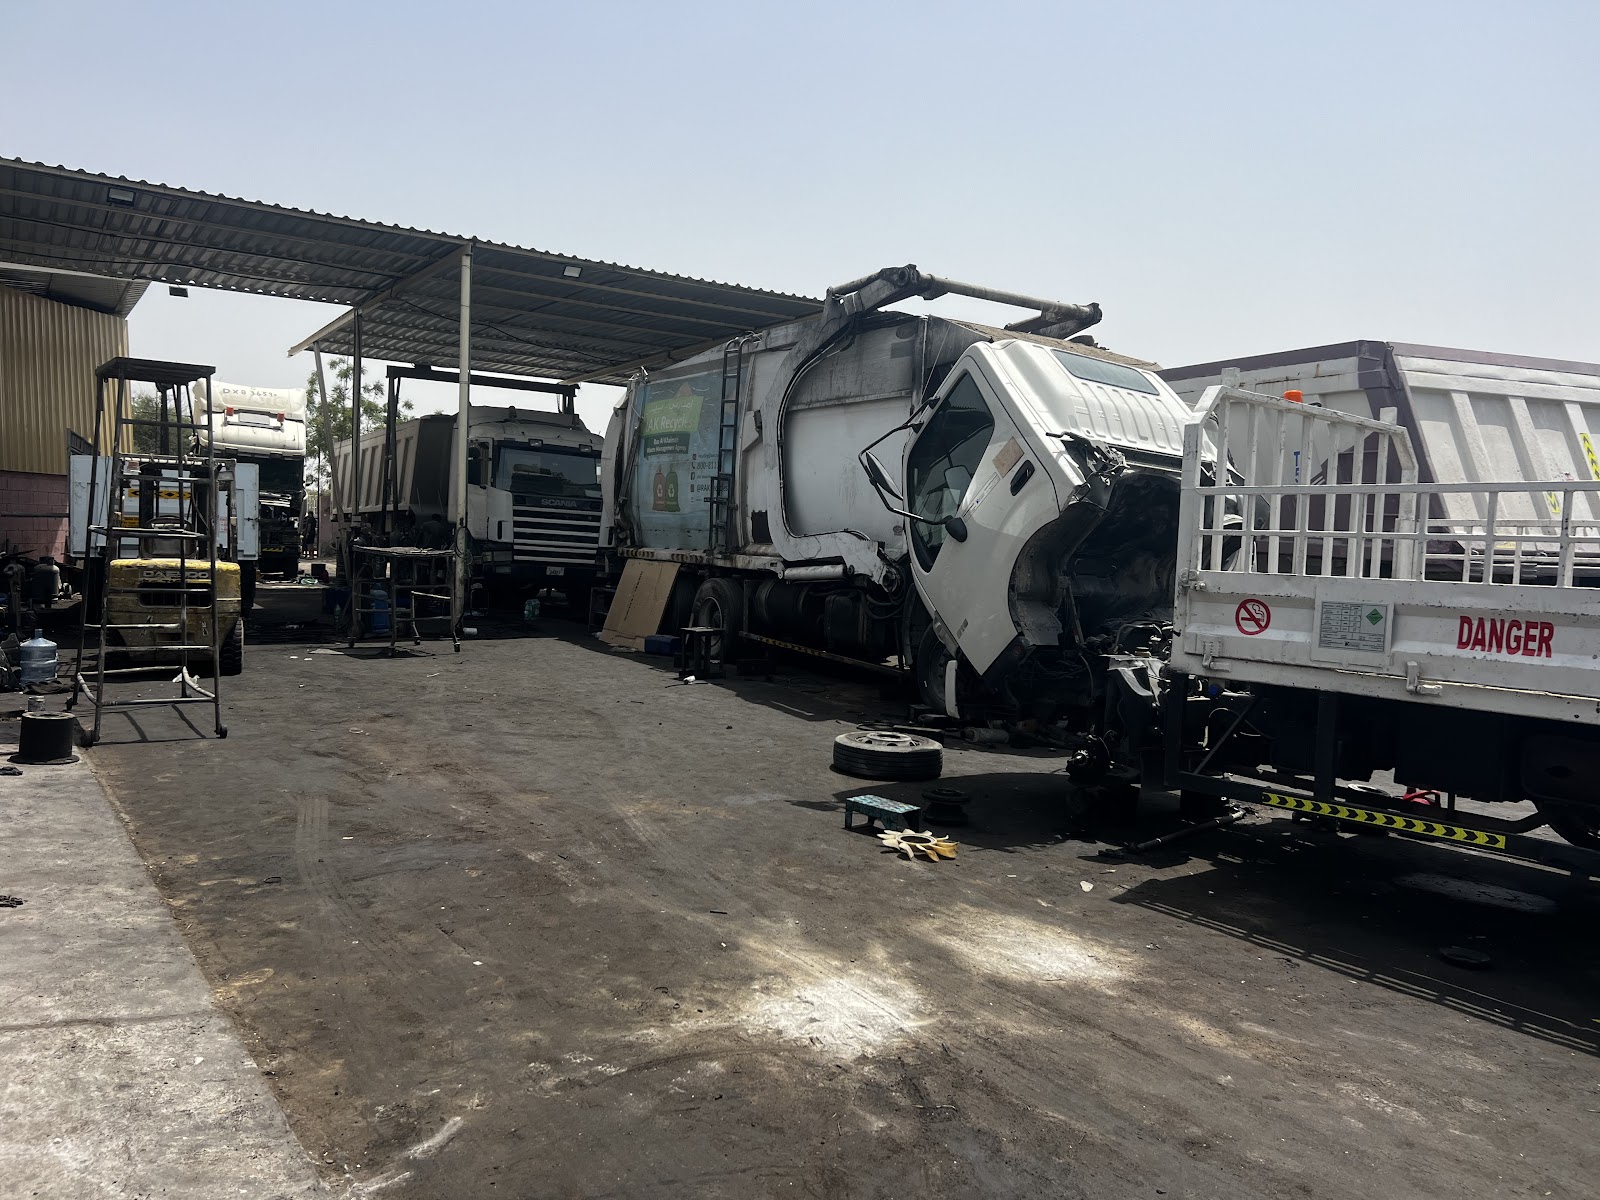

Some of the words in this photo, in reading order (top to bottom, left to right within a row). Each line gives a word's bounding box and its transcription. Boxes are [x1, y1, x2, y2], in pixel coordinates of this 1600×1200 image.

[660, 413, 692, 431] Recycles
[696, 461, 719, 470] 800-811
[541, 498, 577, 508] SCANIA
[142, 570, 209, 579] DAEOO
[1456, 615, 1555, 658] DANGER
